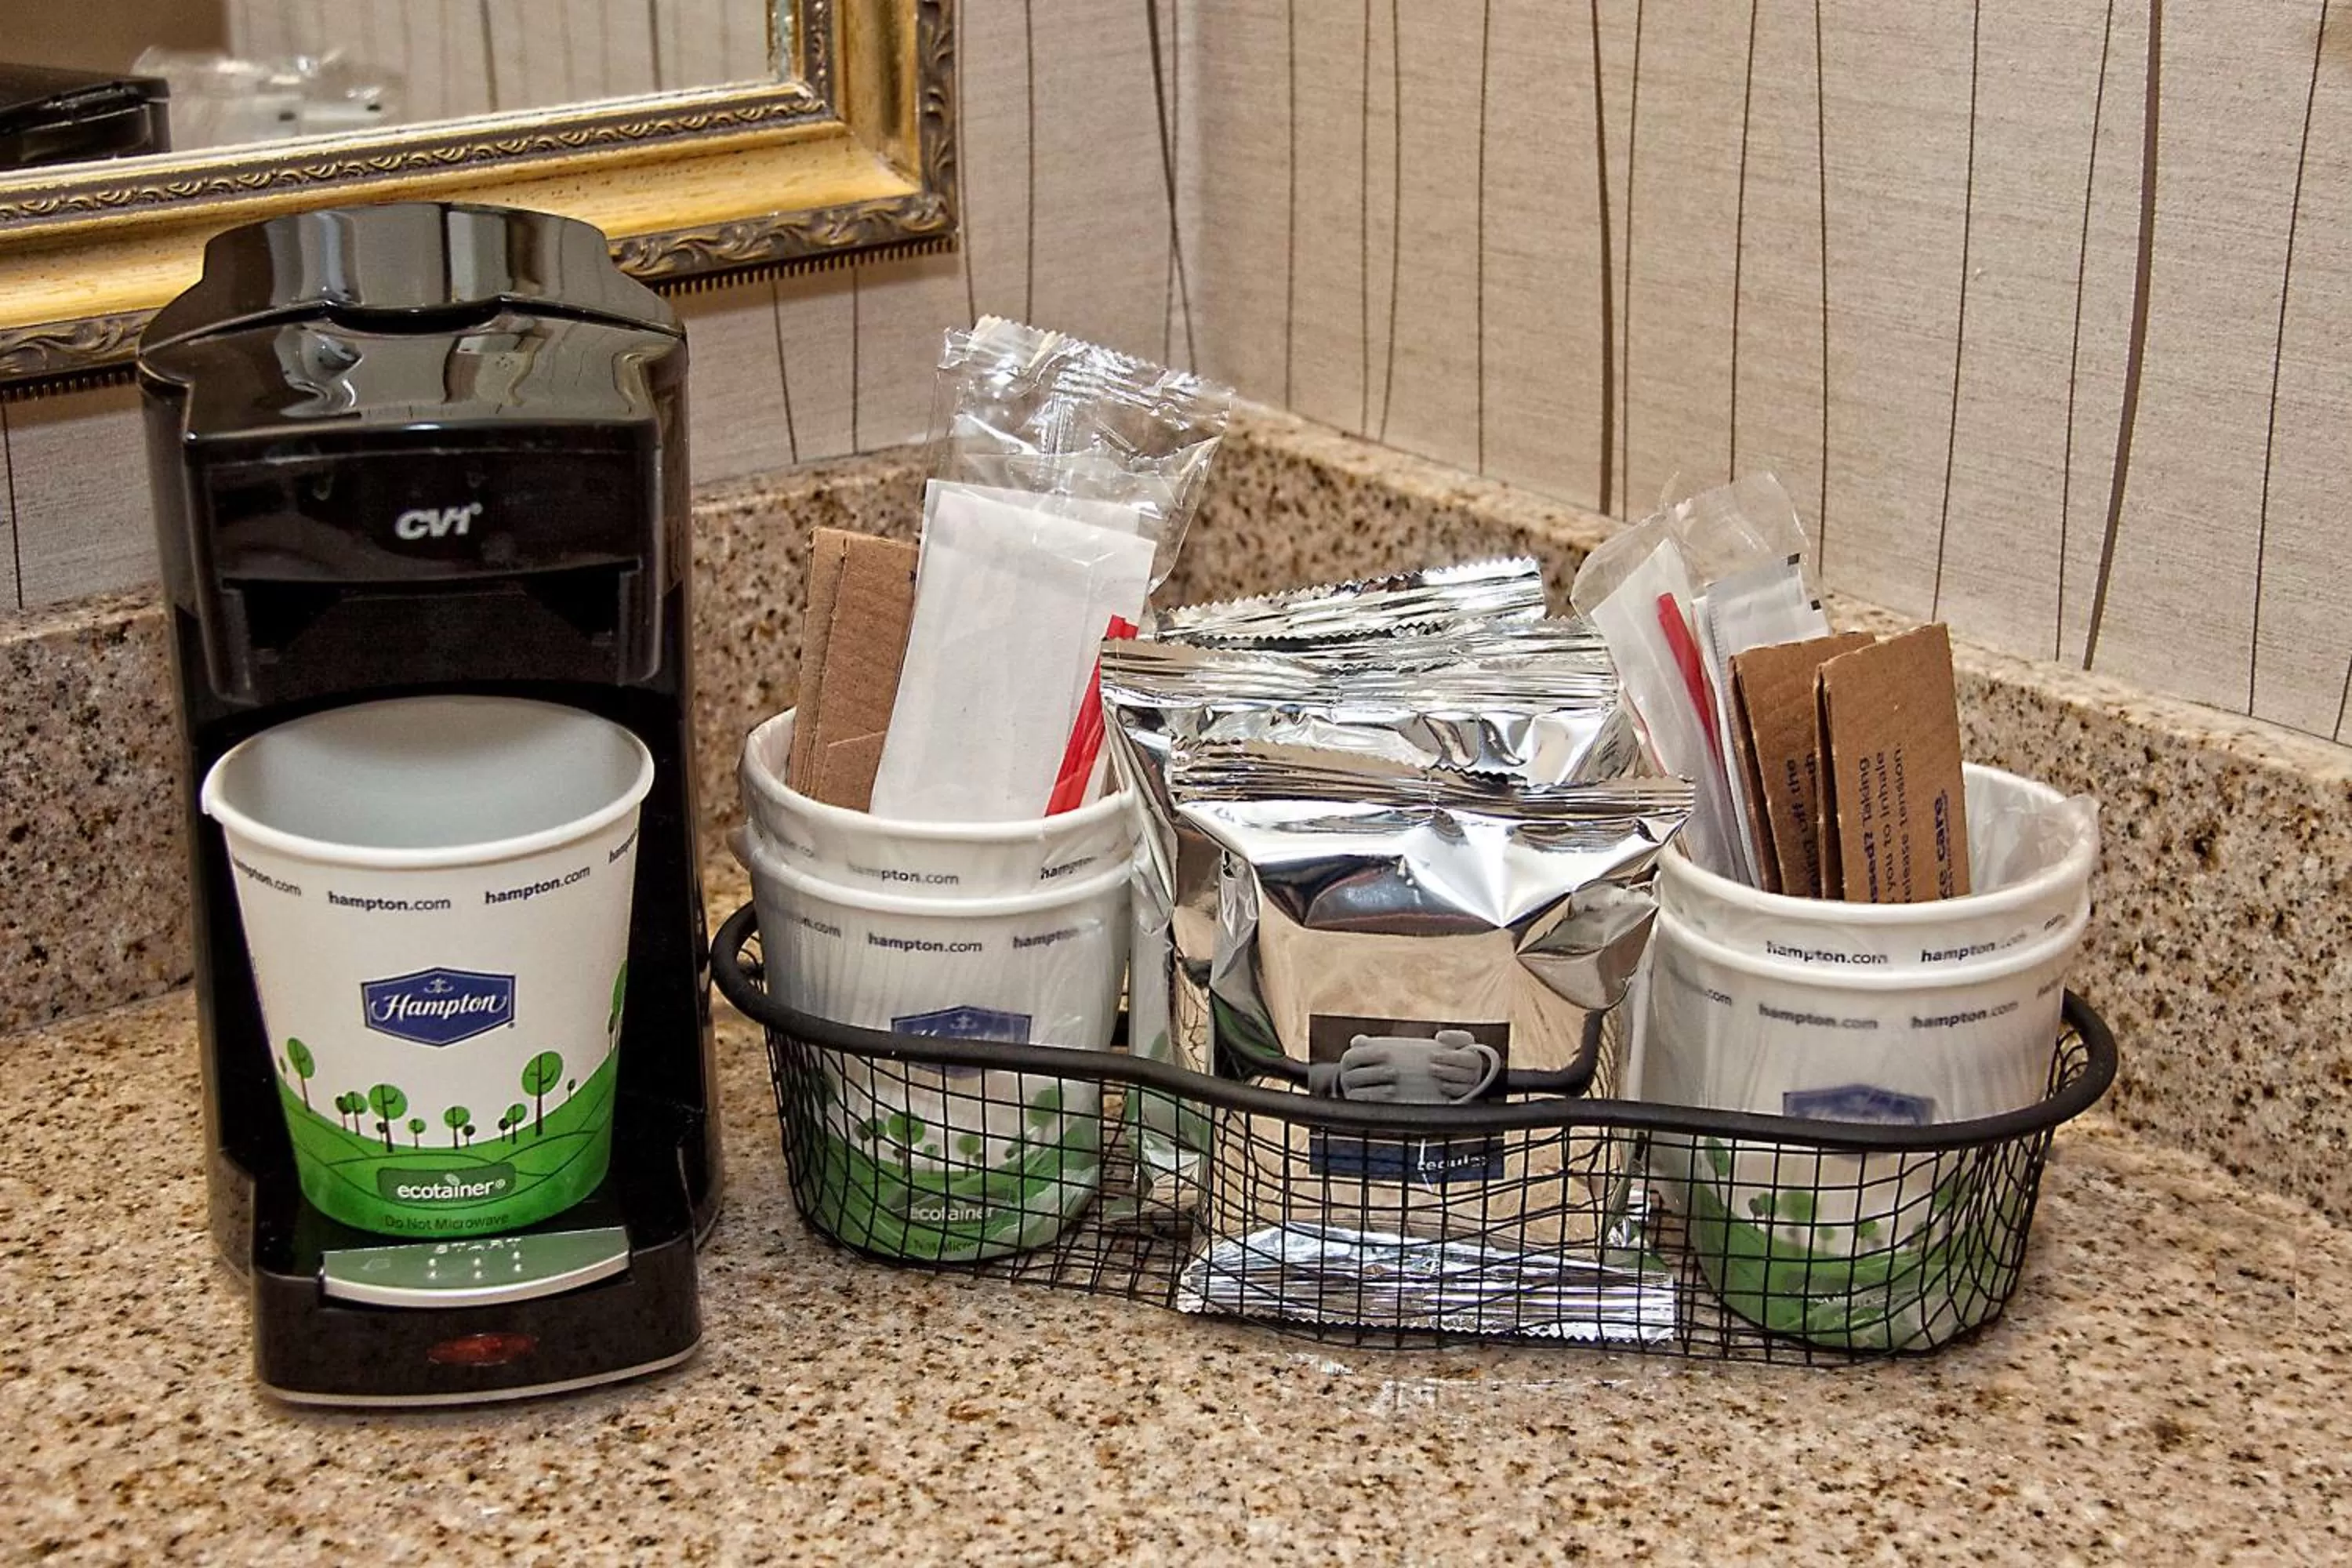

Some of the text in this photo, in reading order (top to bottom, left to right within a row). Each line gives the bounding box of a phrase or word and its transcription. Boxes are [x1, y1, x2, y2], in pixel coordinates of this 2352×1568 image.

[1858, 757, 1873, 826] Taking
[1882, 824, 1892, 847] to
[1885, 853, 1896, 892] you
[485, 866, 590, 905] hampton.com
[328, 891, 452, 911] hampton.com
[868, 932, 982, 953] hampton.com
[1766, 941, 1888, 964] hampton.com
[372, 994, 507, 1022] Hampton
[1911, 1000, 2020, 1029] hampton.com
[385, 1214, 510, 1230] Do Not Microwave
